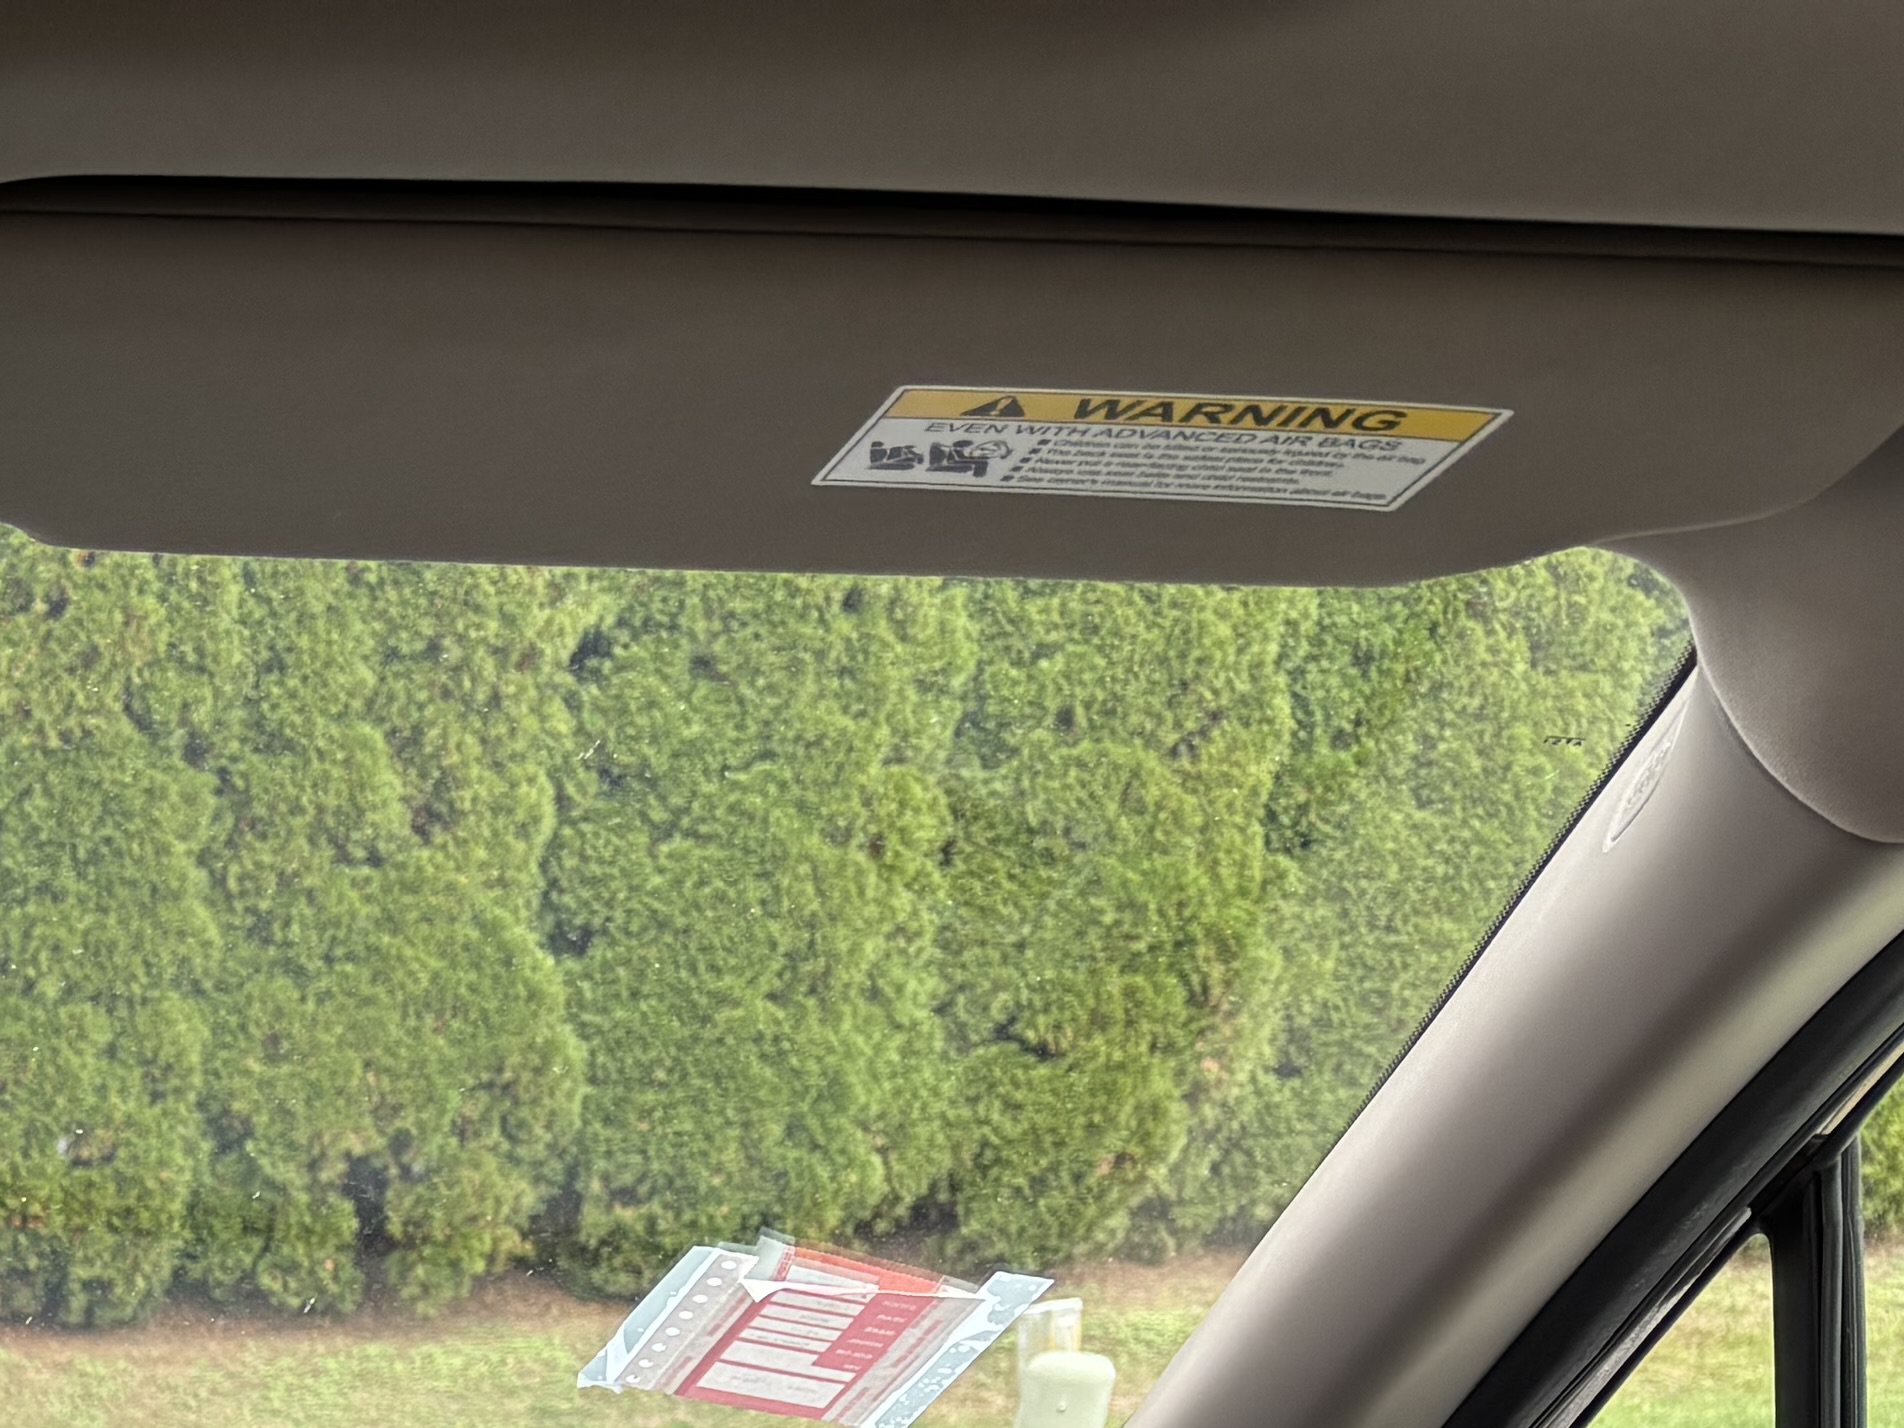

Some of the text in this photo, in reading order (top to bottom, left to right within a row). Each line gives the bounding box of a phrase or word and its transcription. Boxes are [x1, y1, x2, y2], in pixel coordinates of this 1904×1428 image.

[1072, 398, 1409, 432] WARNING
[924, 421, 1404, 451] EVEN WITH ADVANCED AIR BAGS
